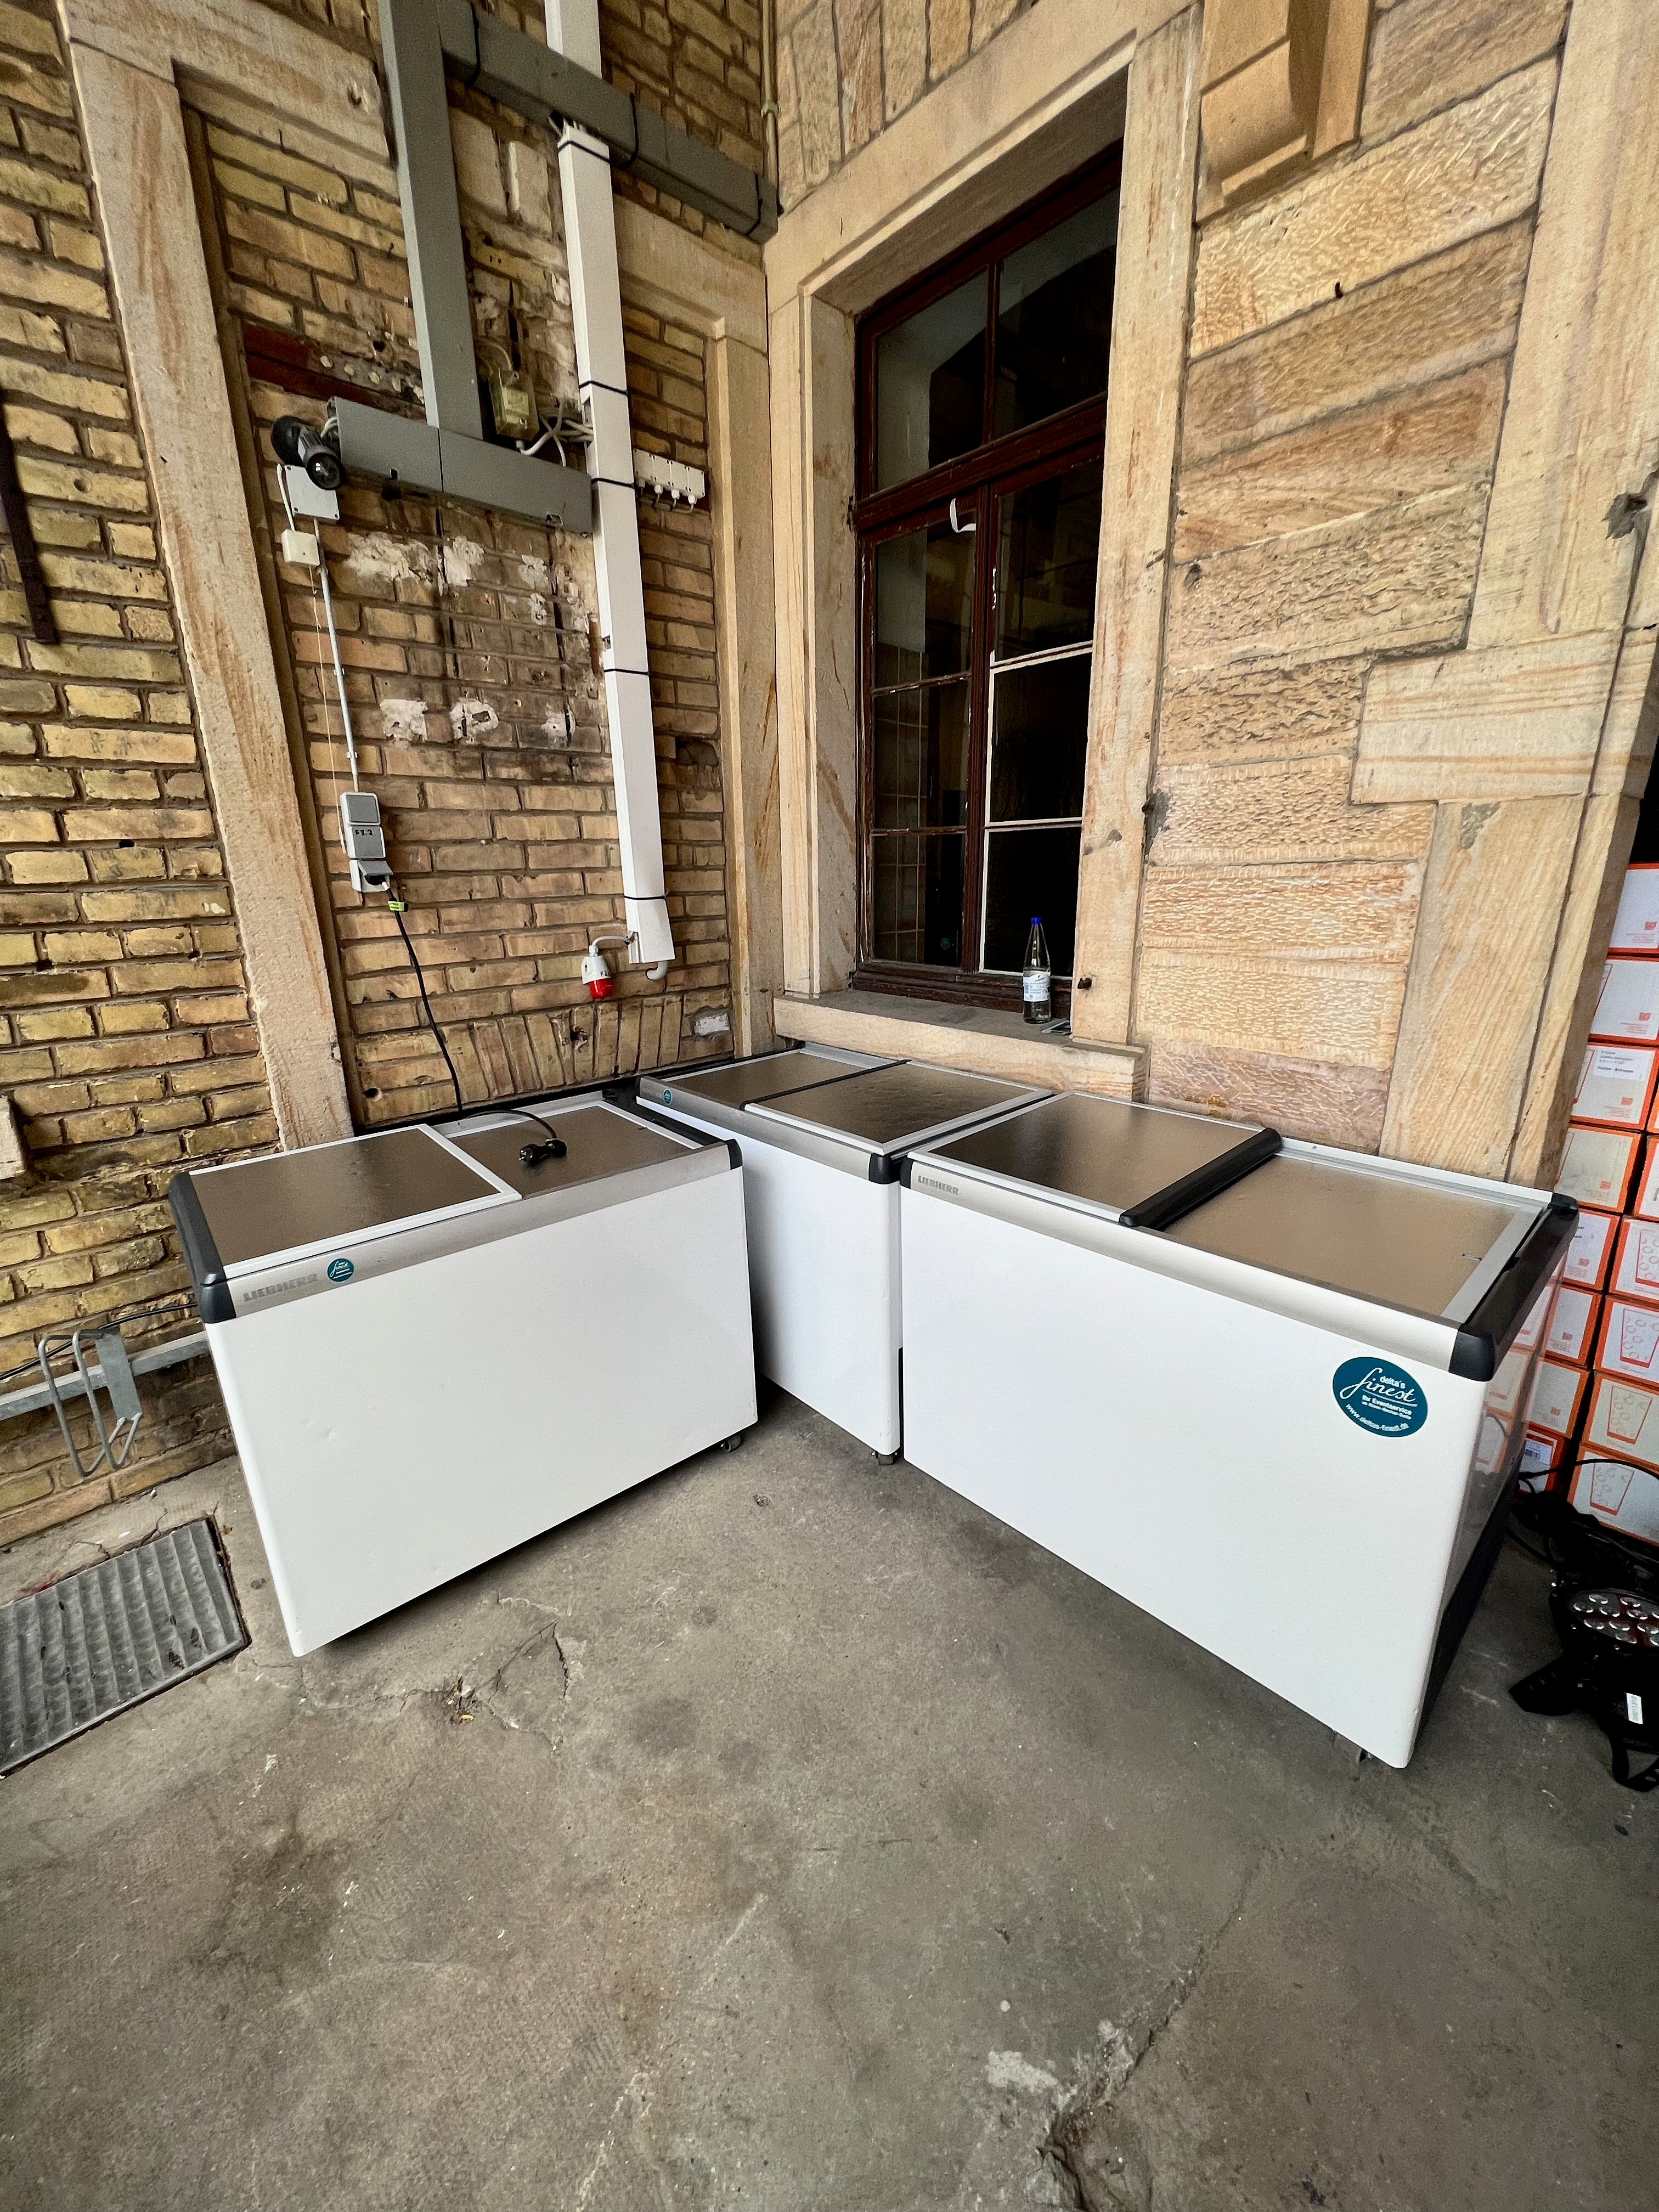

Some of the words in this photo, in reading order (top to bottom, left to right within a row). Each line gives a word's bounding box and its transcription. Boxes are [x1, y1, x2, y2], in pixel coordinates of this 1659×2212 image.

[918, 1175, 959, 1195] LIEBHERR
[243, 1273, 318, 1302] LIEBHERR
[1340, 1367, 1416, 1402] finest
